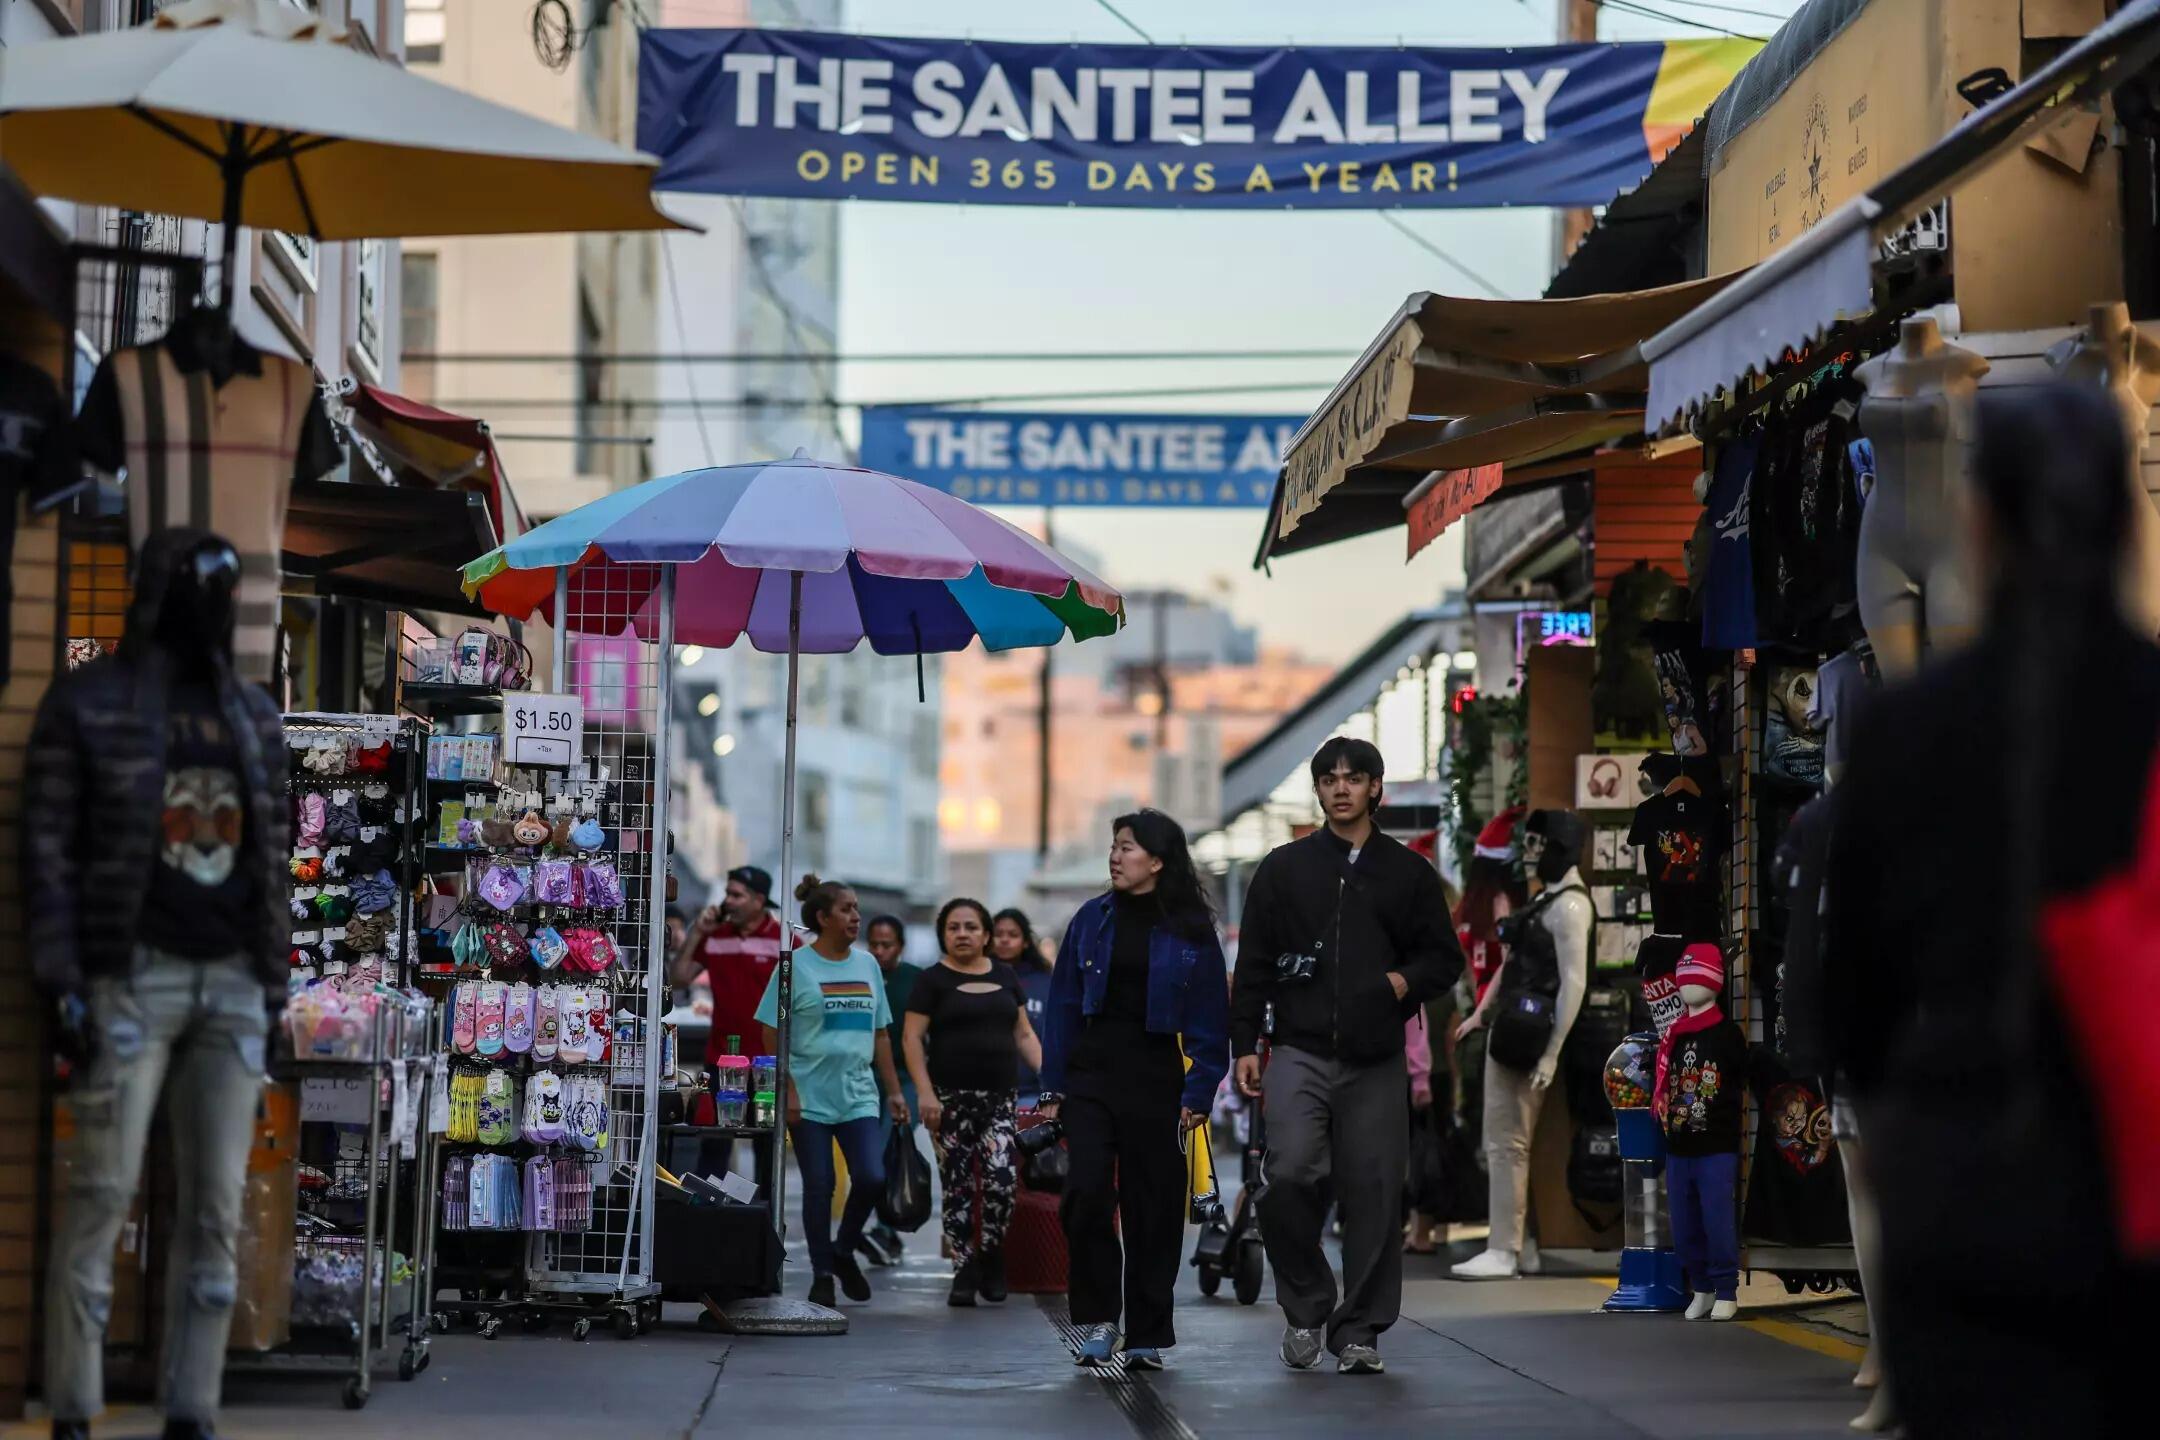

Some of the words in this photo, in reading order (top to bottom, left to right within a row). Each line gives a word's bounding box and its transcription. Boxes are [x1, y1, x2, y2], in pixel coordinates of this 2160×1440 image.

[723, 54, 894, 134] THE
[912, 61, 1255, 144] SANTEE
[1274, 67, 1570, 144] ALLEY
[798, 149, 939, 185] OPEN
[970, 158, 1057, 190] 365
[1088, 161, 1216, 192] DAYS
[1245, 163, 1274, 192] A
[1303, 161, 1460, 193] YEAR!
[905, 419, 1012, 469] THE
[1019, 421, 1226, 472] SANTEE
[515, 706, 572, 732] $1.50
